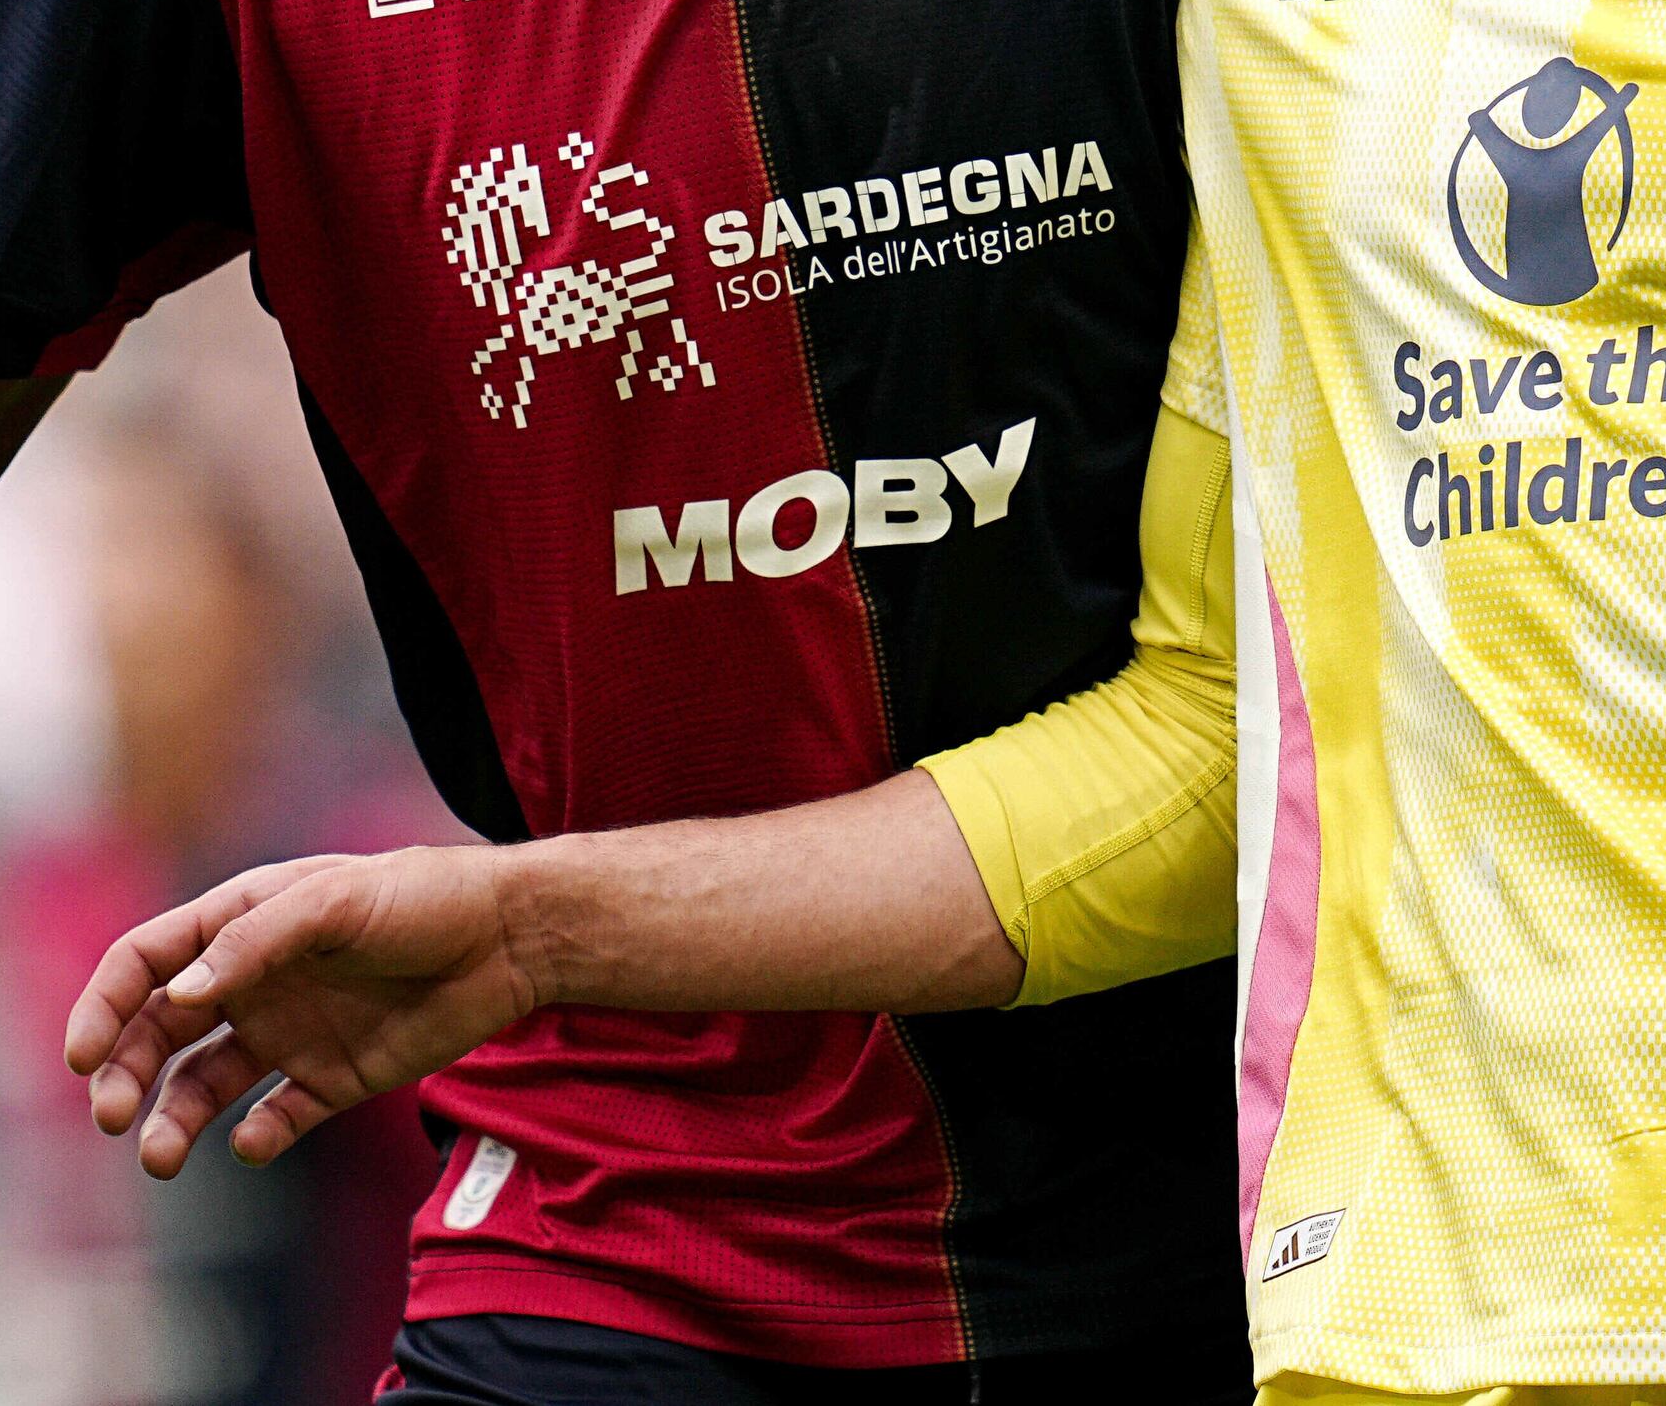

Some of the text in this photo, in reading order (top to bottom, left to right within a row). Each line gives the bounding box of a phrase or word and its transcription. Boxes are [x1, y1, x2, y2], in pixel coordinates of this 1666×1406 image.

[703, 140, 1114, 268] SARDEGNA
[715, 207, 1116, 313] ISOLA dell'Artigianato
[1393, 340, 1564, 432] Save
[613, 416, 1037, 596] MOBY
